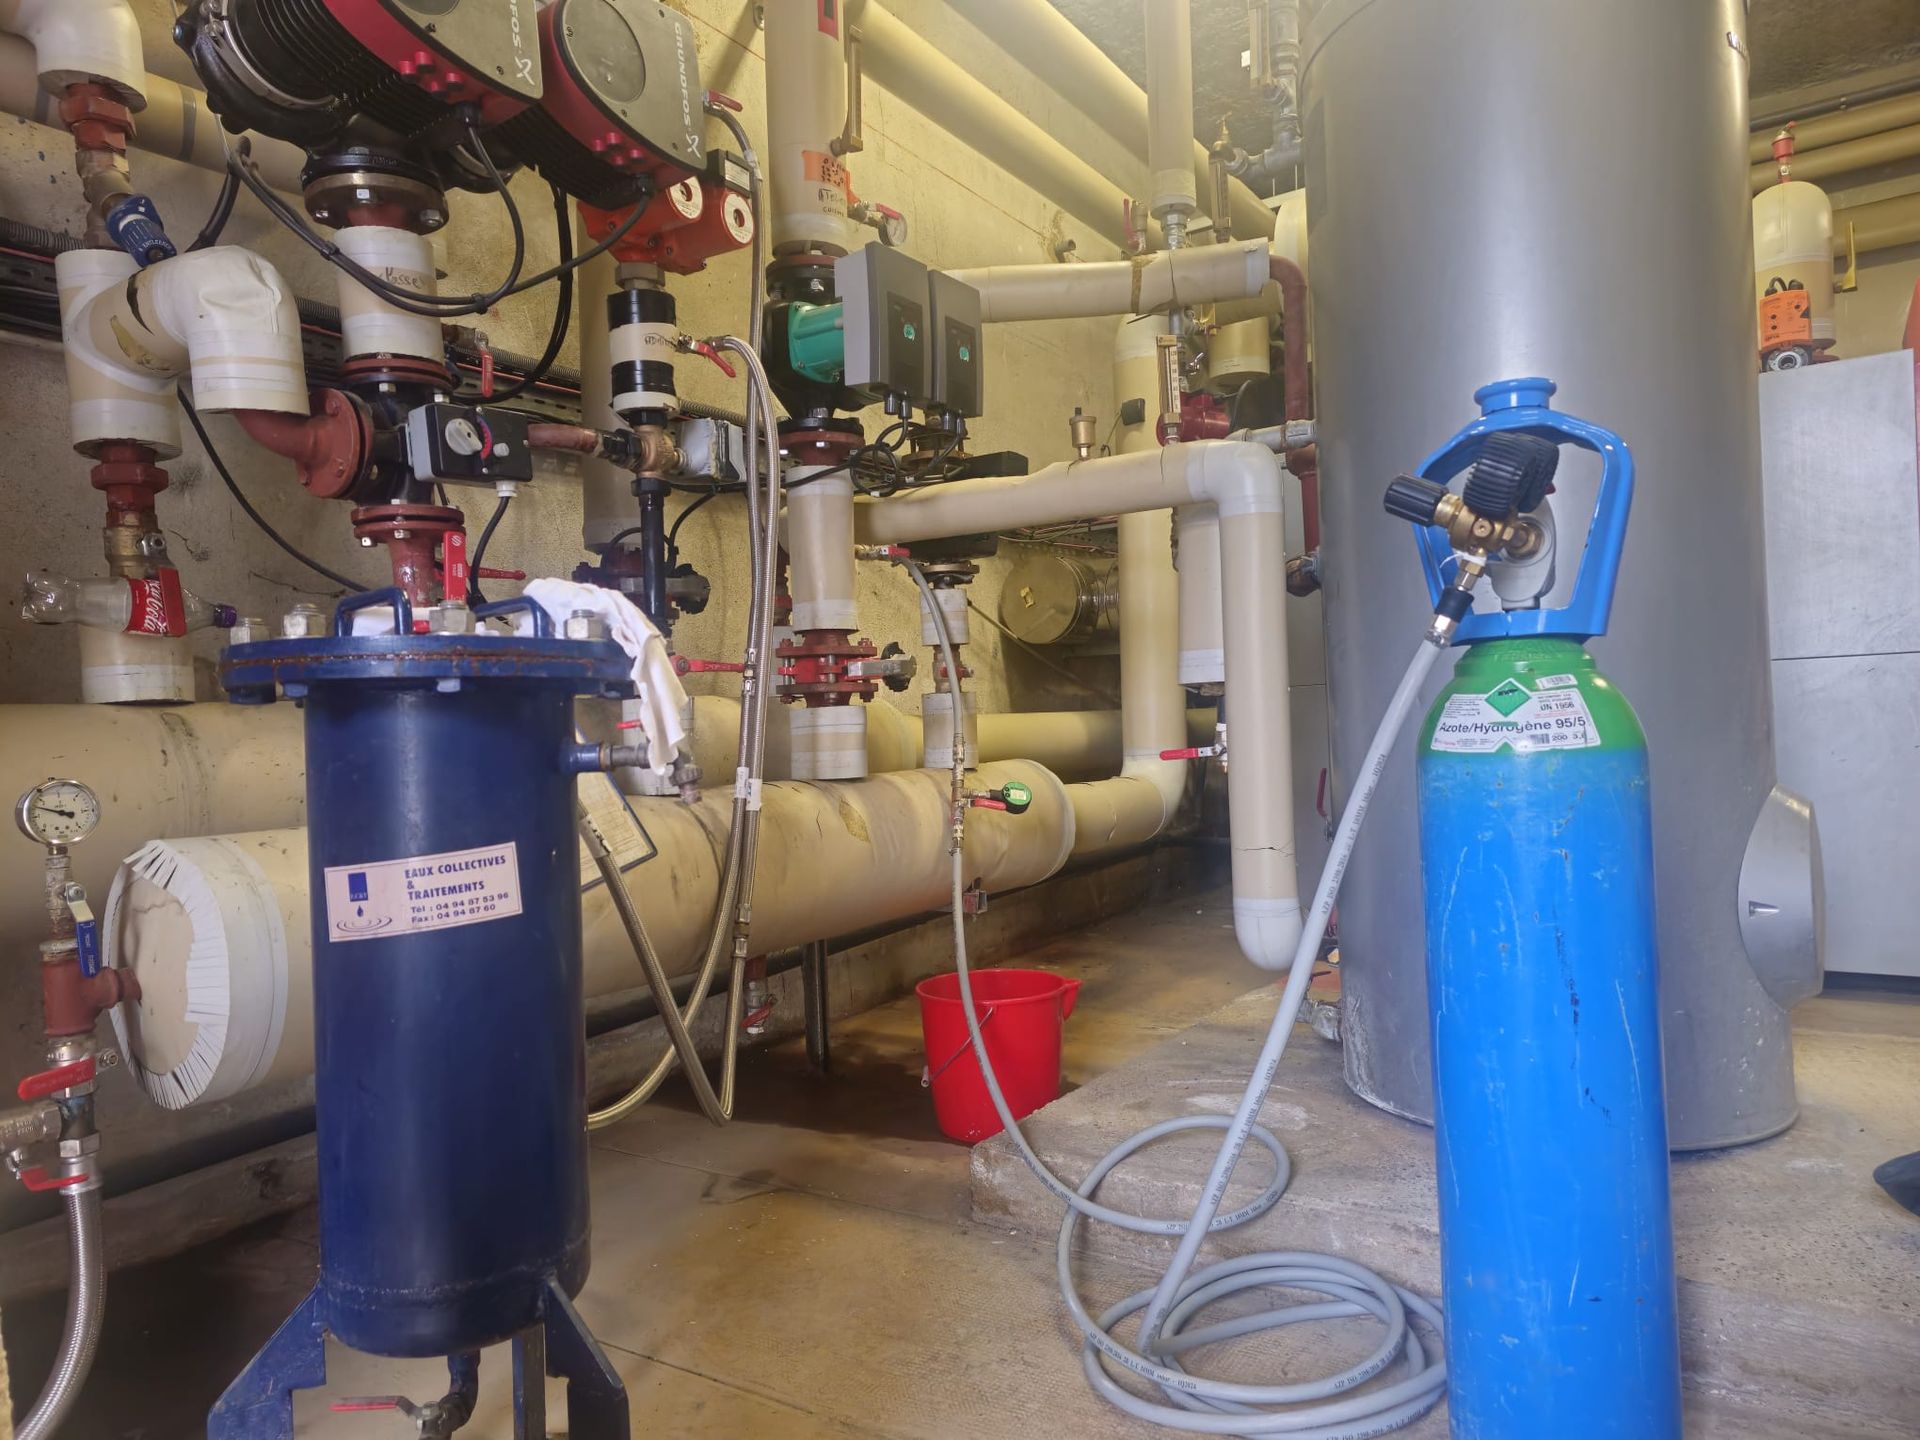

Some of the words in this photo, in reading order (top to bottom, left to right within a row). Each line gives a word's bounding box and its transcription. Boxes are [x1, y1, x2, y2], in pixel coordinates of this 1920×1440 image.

[674, 21, 692, 126] GRUNDFOS
[1555, 716, 1586, 729] 95/5
[404, 866, 434, 879] EAUX
[438, 855, 506, 875] COLLECTIVES
[406, 880, 415, 890] &
[407, 881, 485, 901] TRAITEMENTS
[435, 903, 449, 911] 04
[452, 900, 465, 909] 94
[468, 897, 480, 906] 87
[436, 912, 450, 920] 04
[453, 909, 466, 917] 94
[483, 903, 496, 911] 60
